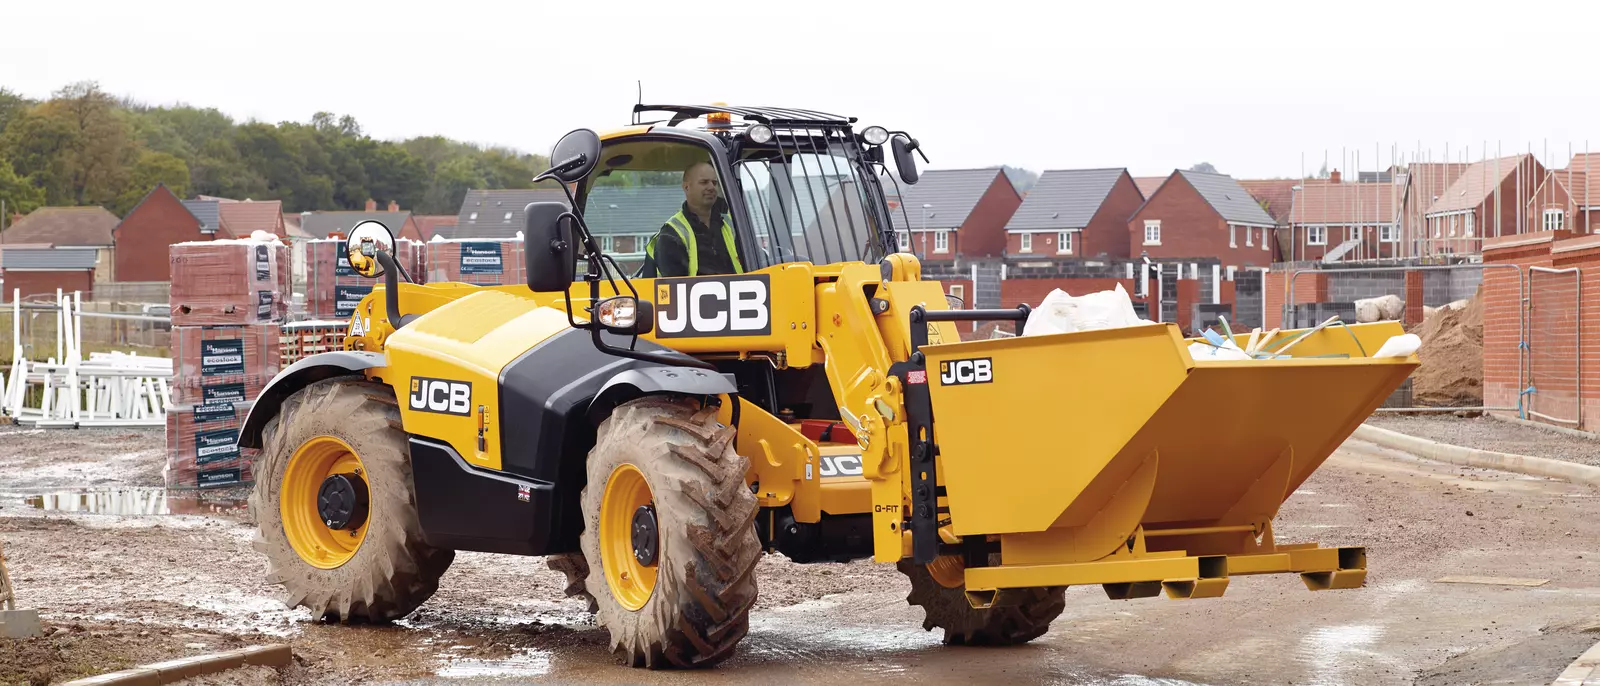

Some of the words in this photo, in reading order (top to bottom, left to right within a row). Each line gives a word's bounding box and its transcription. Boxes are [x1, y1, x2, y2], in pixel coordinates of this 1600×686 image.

[657, 280, 769, 333] JCB
[212, 346, 238, 354] Hanson
[941, 359, 992, 384] JCB
[411, 380, 470, 413] JCB
